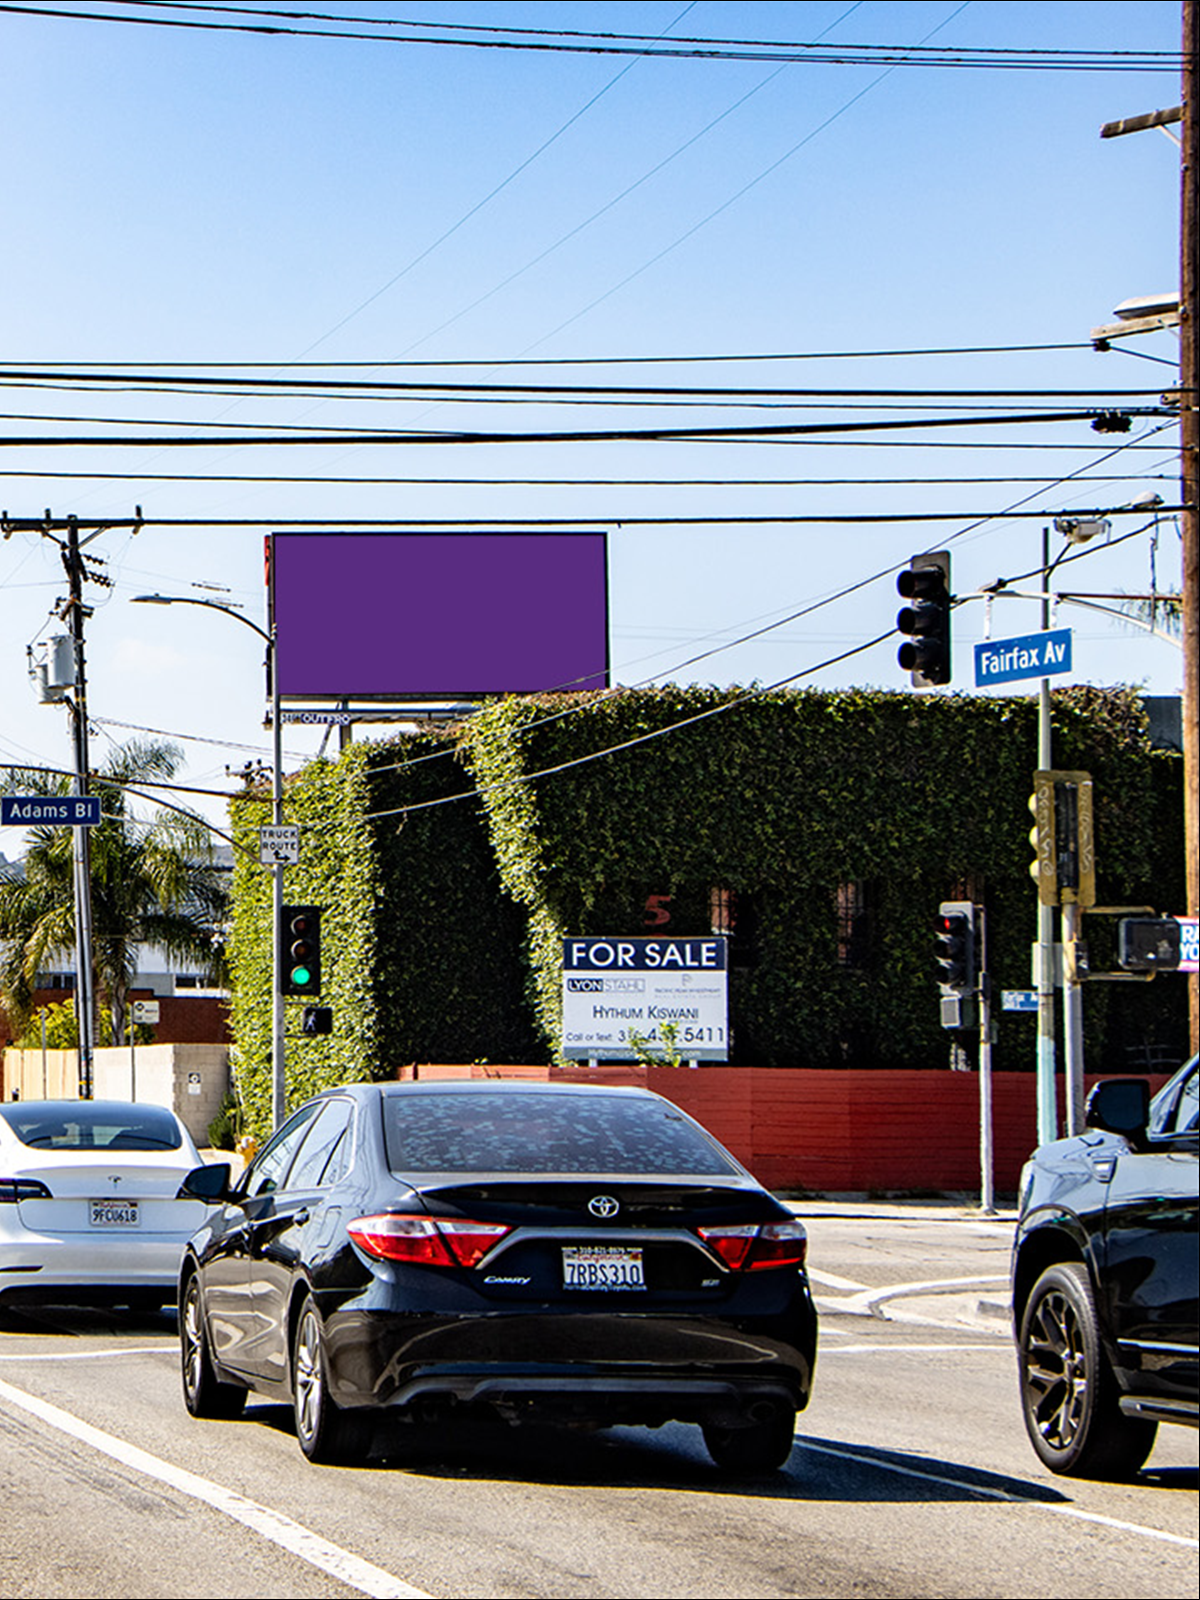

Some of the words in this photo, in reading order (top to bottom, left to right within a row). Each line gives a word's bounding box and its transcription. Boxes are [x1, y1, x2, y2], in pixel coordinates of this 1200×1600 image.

[981, 646, 1040, 675] Fairfax
[1043, 640, 1066, 665] Av
[9, 802, 68, 819] Adams
[75, 802, 92, 819] Bl
[262, 829, 297, 838] TRUCK
[262, 841, 297, 850] ROUTE
[571, 942, 636, 967] FOR
[644, 942, 717, 967] SALE
[568, 979, 603, 992] LYON
[604, 979, 645, 992] STAHL
[593, 1005, 643, 1019] HYTHUM
[647, 1005, 699, 1019] KISWANI
[566, 1032, 583, 1042] Call
[585, 1034, 594, 1042] or
[566, 1263, 641, 1286] 7RBS310
